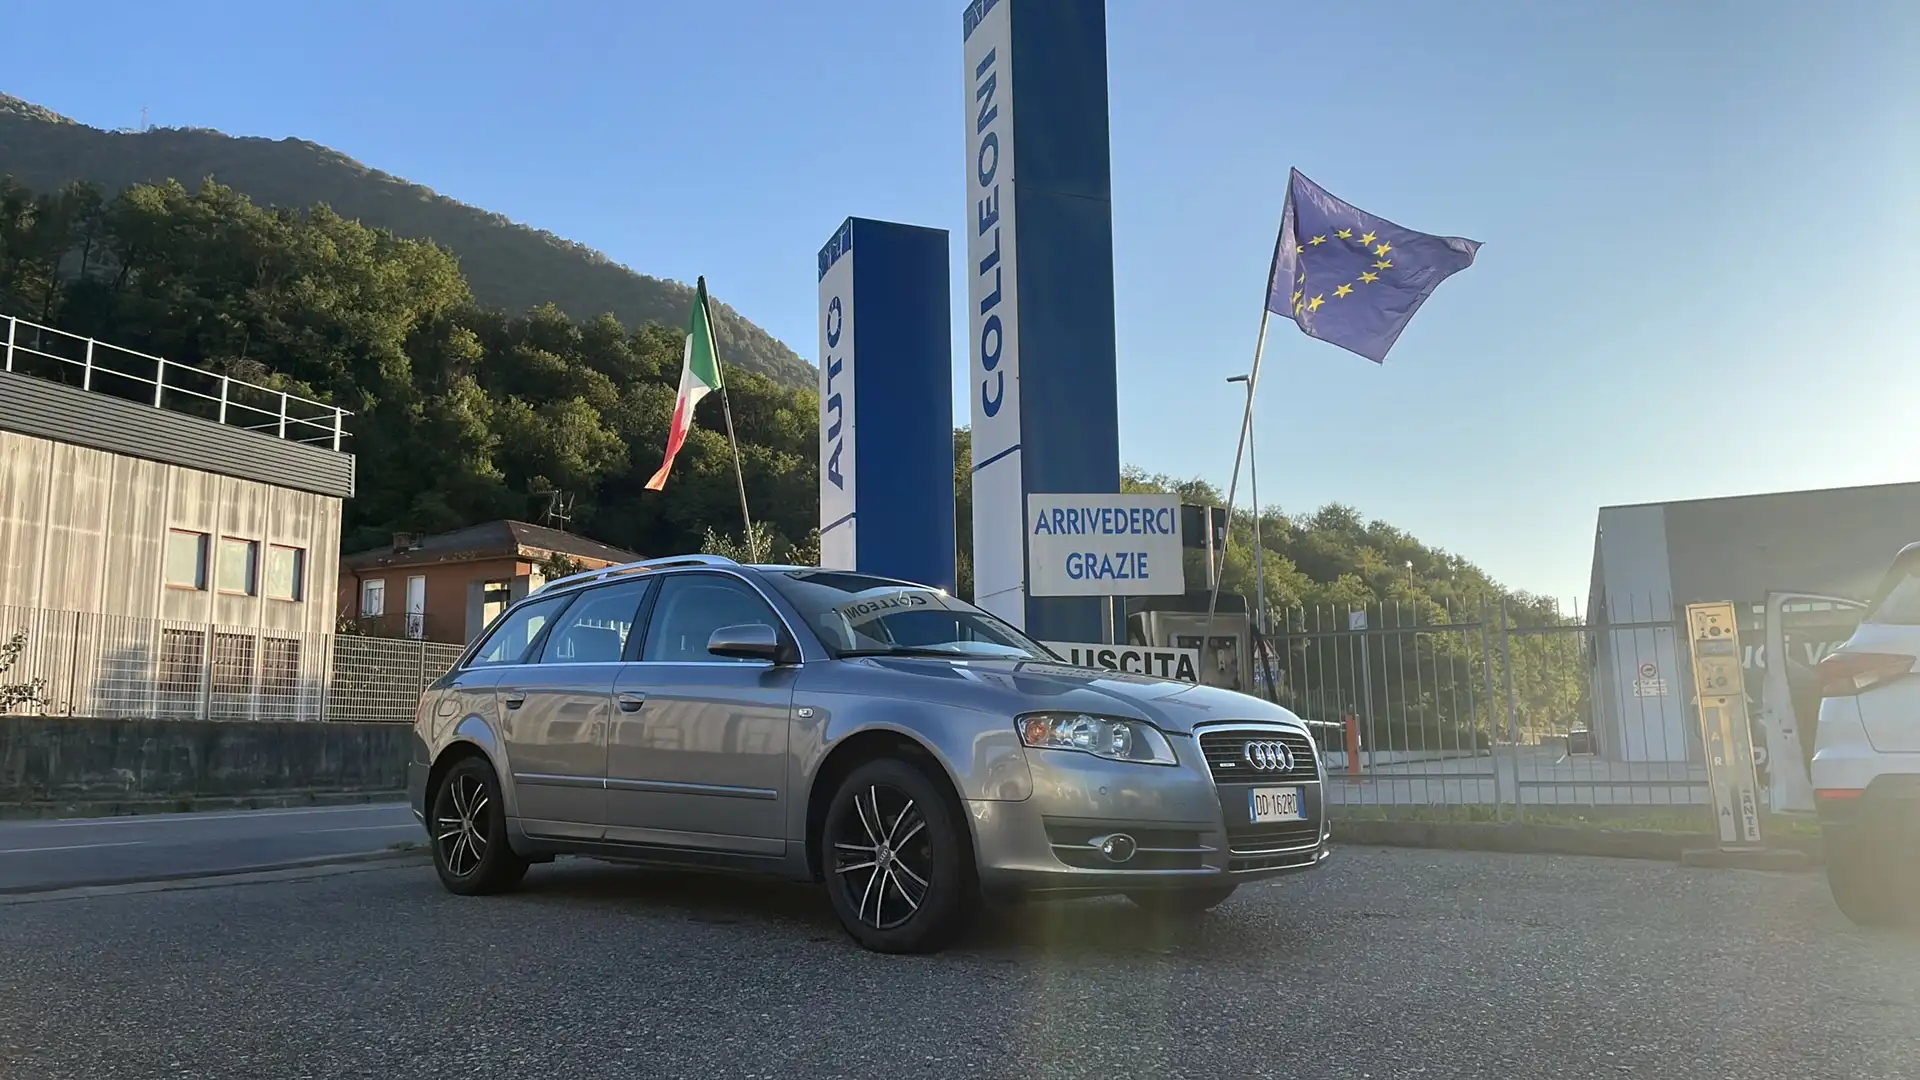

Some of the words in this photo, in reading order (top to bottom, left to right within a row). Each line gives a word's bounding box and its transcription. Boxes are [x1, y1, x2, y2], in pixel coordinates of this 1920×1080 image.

[975, 46, 1004, 418] COLLEONI
[827, 295, 844, 491] AUTO
[1034, 507, 1176, 535] ARRIVEDERCI
[1066, 552, 1149, 580] GRAZIE
[1071, 648, 1198, 682] USCITA
[1255, 794, 1269, 816] DD
